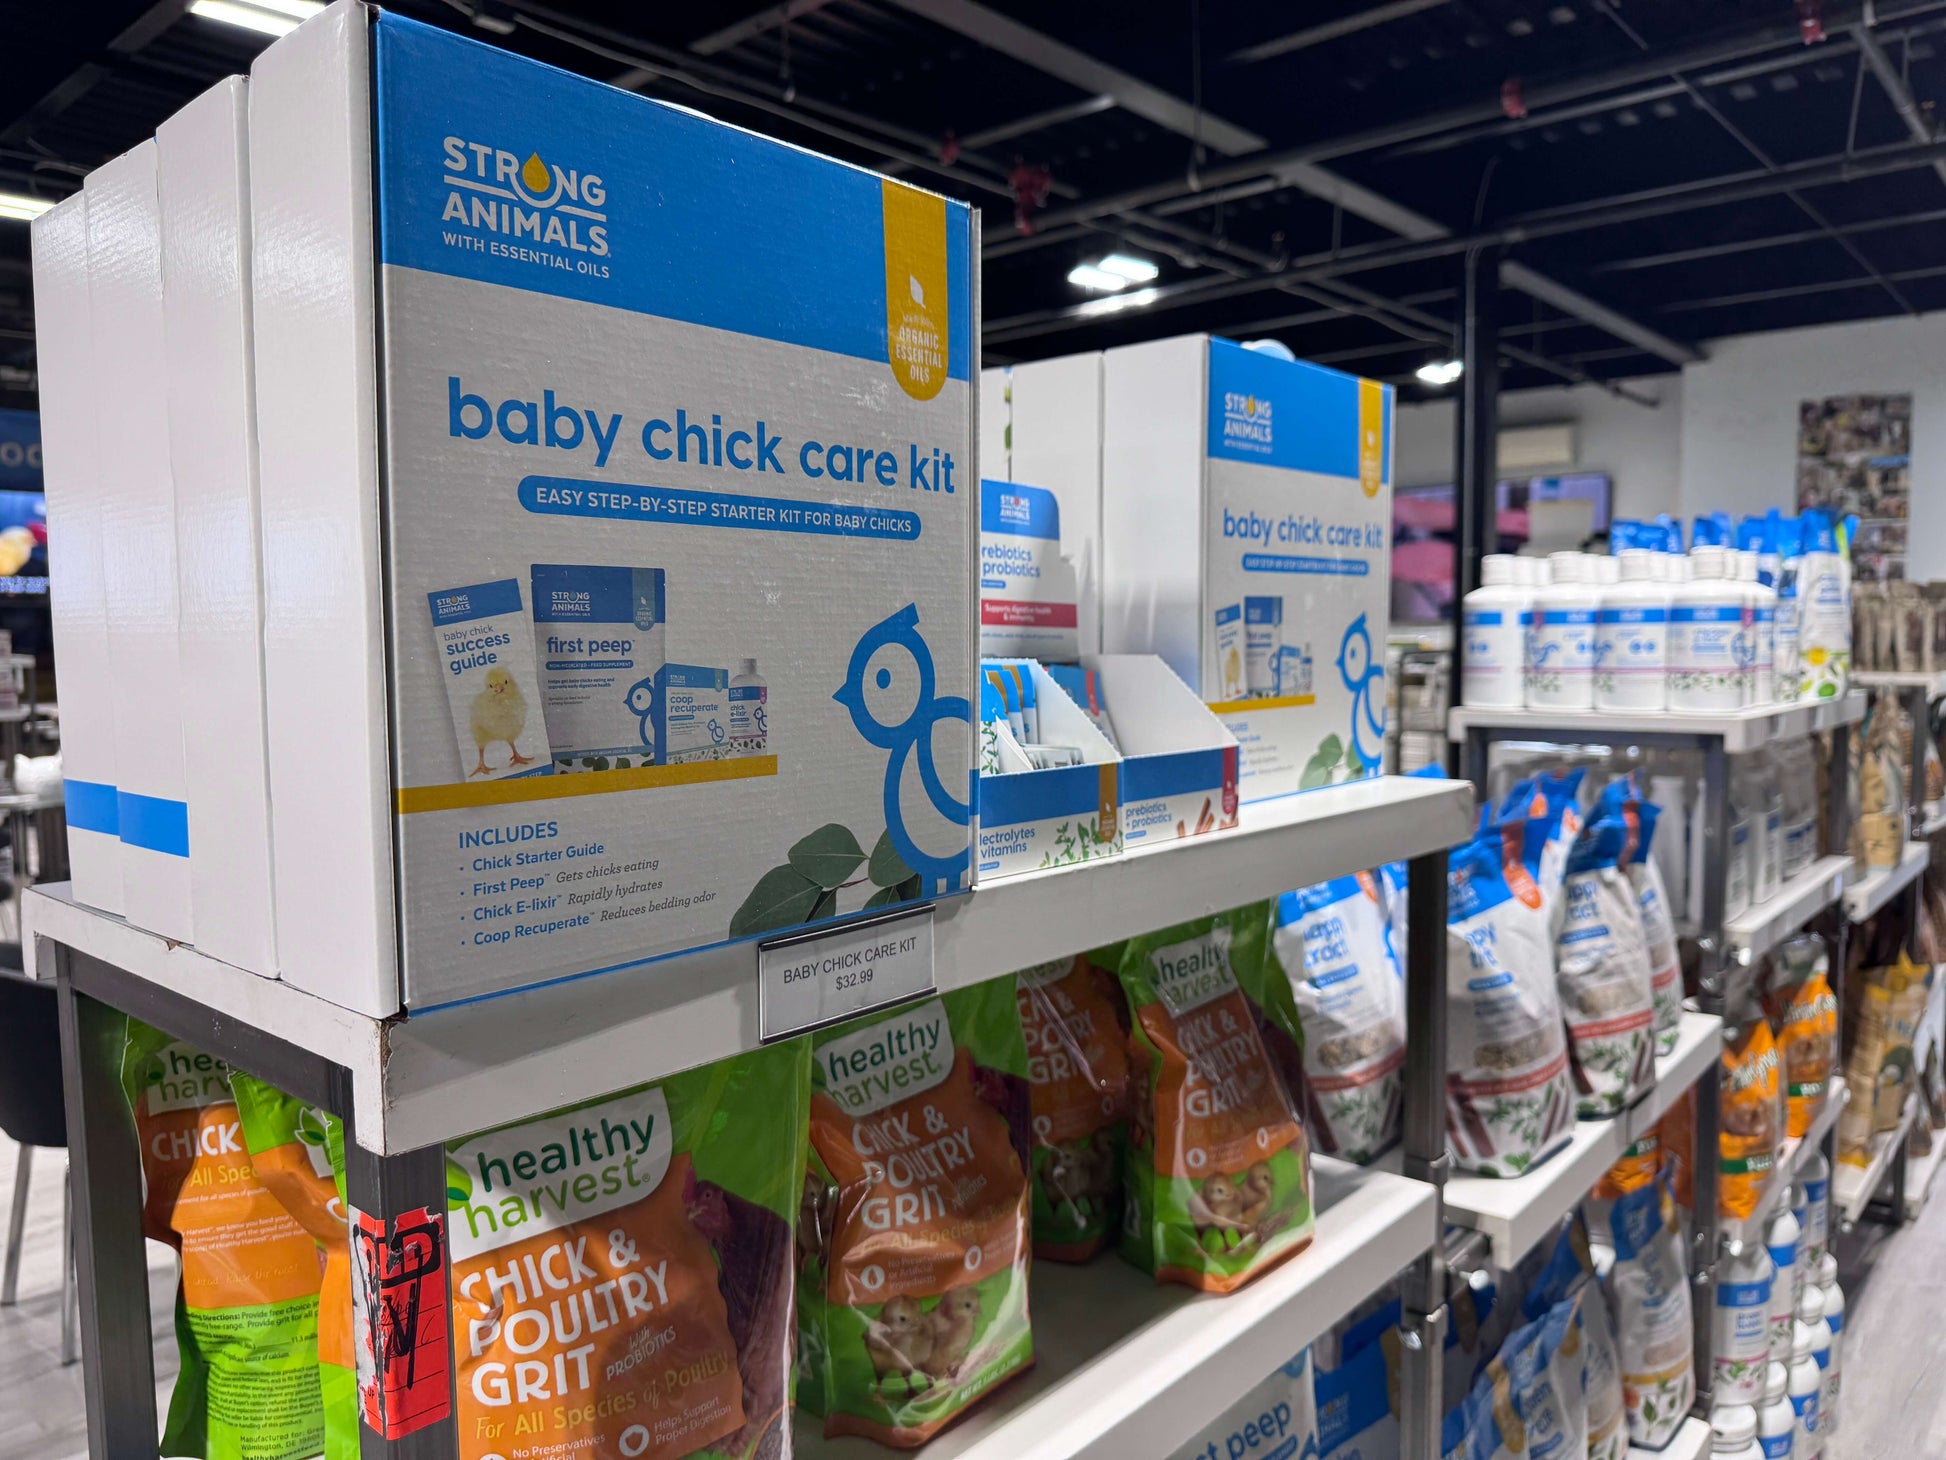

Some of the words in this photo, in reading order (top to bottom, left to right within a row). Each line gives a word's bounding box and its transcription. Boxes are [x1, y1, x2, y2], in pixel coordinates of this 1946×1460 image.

[442, 136, 607, 208] STRONG
[441, 191, 609, 256] ANIMALS
[442, 231, 485, 253] WITH
[490, 242, 573, 271] ESSENTIAL
[577, 261, 610, 279] OILS
[899, 326, 939, 350] ORGANIC
[896, 343, 943, 369] ESSENTIAL
[910, 364, 930, 384] OILS
[1225, 393, 1273, 421] STRONG
[448, 376, 622, 467] baby
[641, 409, 785, 474] chick
[800, 441, 898, 487] care
[910, 445, 955, 494] kit
[1224, 419, 1273, 443] ANIMALS
[536, 487, 584, 507] EASY
[587, 491, 707, 517] STEP-BY-STEP
[711, 502, 776, 522] STARTER
[779, 507, 802, 524] KIT
[804, 509, 832, 527] FOR
[834, 513, 867, 530] BABY
[869, 515, 912, 533] CHICKS
[1223, 508, 1273, 548] baby
[1277, 515, 1323, 545] chick
[1327, 524, 1362, 547] care
[1364, 522, 1383, 549] kit
[981, 545, 1032, 562] rebiotics
[983, 560, 1040, 578] probiotics
[438, 603, 471, 615] ANIMALS
[552, 591, 590, 603] STRONG
[552, 603, 590, 611] ANIMALS
[444, 630, 467, 641] baby
[470, 625, 494, 636] chick
[447, 633, 510, 655] success
[546, 636, 583, 653] first
[588, 639, 632, 656] peep
[450, 651, 497, 675] guide
[670, 696, 693, 705] coop
[670, 704, 718, 713] recuperate
[1125, 802, 1167, 821] prebiotics
[1132, 813, 1172, 829] probiotics
[458, 821, 558, 849] INCLUDES
[472, 855, 511, 872] Chick
[515, 849, 563, 866] Starter
[566, 843, 604, 858] Guide
[981, 842, 1027, 859] vitamins
[473, 880, 506, 897] First
[556, 871, 583, 883] Gets
[585, 863, 622, 880] chicks
[624, 858, 659, 875] eating
[473, 905, 512, 922] Chick
[568, 889, 612, 906] Rapidly
[615, 880, 663, 899] hydrates
[474, 929, 511, 946] Coop
[600, 904, 646, 922] Reduces
[648, 895, 691, 913] bedding
[693, 891, 717, 905] odor
[783, 961, 820, 984] BABY
[823, 951, 862, 974] CHICK
[864, 942, 897, 962] CARE
[899, 936, 917, 953] KIT
[835, 968, 874, 991] $32.99
[829, 1018, 939, 1082] healthy
[923, 1104, 948, 1134] &
[151, 1121, 242, 1161] CHICK
[477, 1113, 654, 1193] healthy
[861, 1126, 975, 1189] POULTRY
[190, 1167, 213, 1187] All
[861, 1184, 945, 1230] GRIT
[459, 1236, 597, 1315] CHICK
[608, 1228, 641, 1268] &
[241, 1311, 267, 1319] Provide
[285, 1303, 312, 1312] choice
[468, 1259, 670, 1357] POULTRY
[247, 1319, 274, 1328] Provide
[630, 1325, 651, 1350] With
[605, 1324, 678, 1382] PROBIOTICS
[471, 1343, 596, 1407] GRIT
[475, 1416, 505, 1440] For
[513, 1410, 544, 1436] All
[553, 1390, 637, 1430] Species
[643, 1379, 661, 1411] of
[664, 1351, 729, 1393] Poultry
[654, 1414, 683, 1434] Helps
[683, 1396, 720, 1420] Support
[655, 1423, 689, 1445] Proper
[689, 1405, 732, 1432] Digestion
[240, 1433, 289, 1443] Manufactured
[1226, 1401, 1291, 1460] peep
[241, 1443, 284, 1451] Wilmington,
[512, 1447, 529, 1459] No
[532, 1432, 606, 1456] Preservatives
